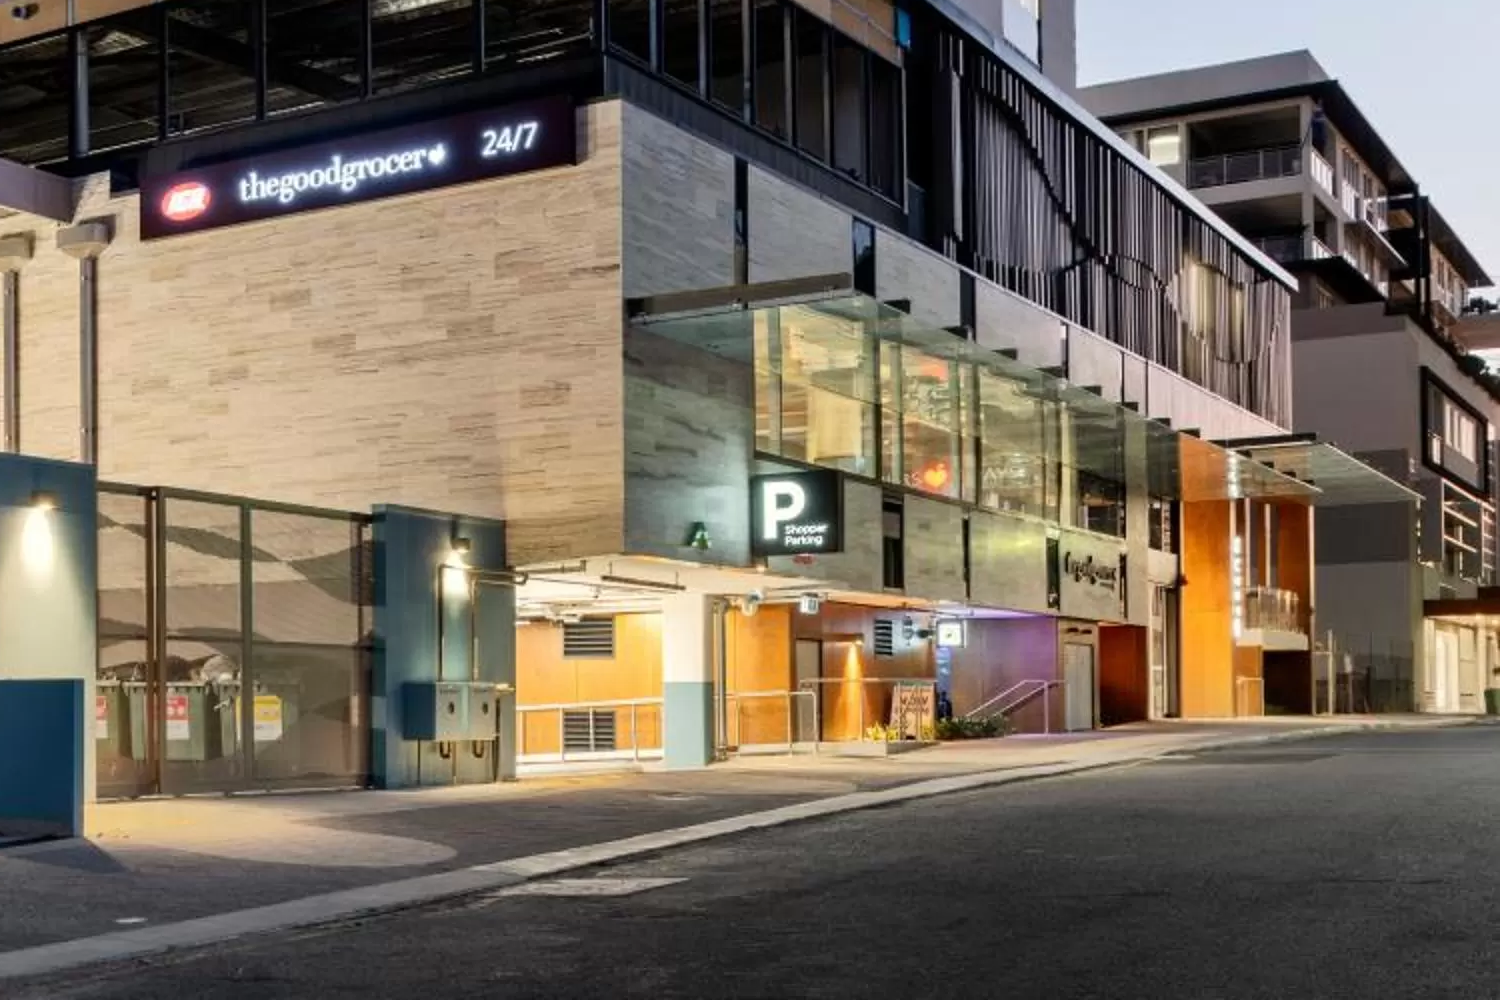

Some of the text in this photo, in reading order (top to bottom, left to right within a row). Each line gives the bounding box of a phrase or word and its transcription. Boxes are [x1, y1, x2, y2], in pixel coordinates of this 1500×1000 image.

[239, 147, 427, 203] thegoodgrocer
[480, 121, 539, 157] 24/7
[763, 480, 805, 540] P
[784, 522, 828, 535] Shopper
[784, 535, 824, 547] Parking
